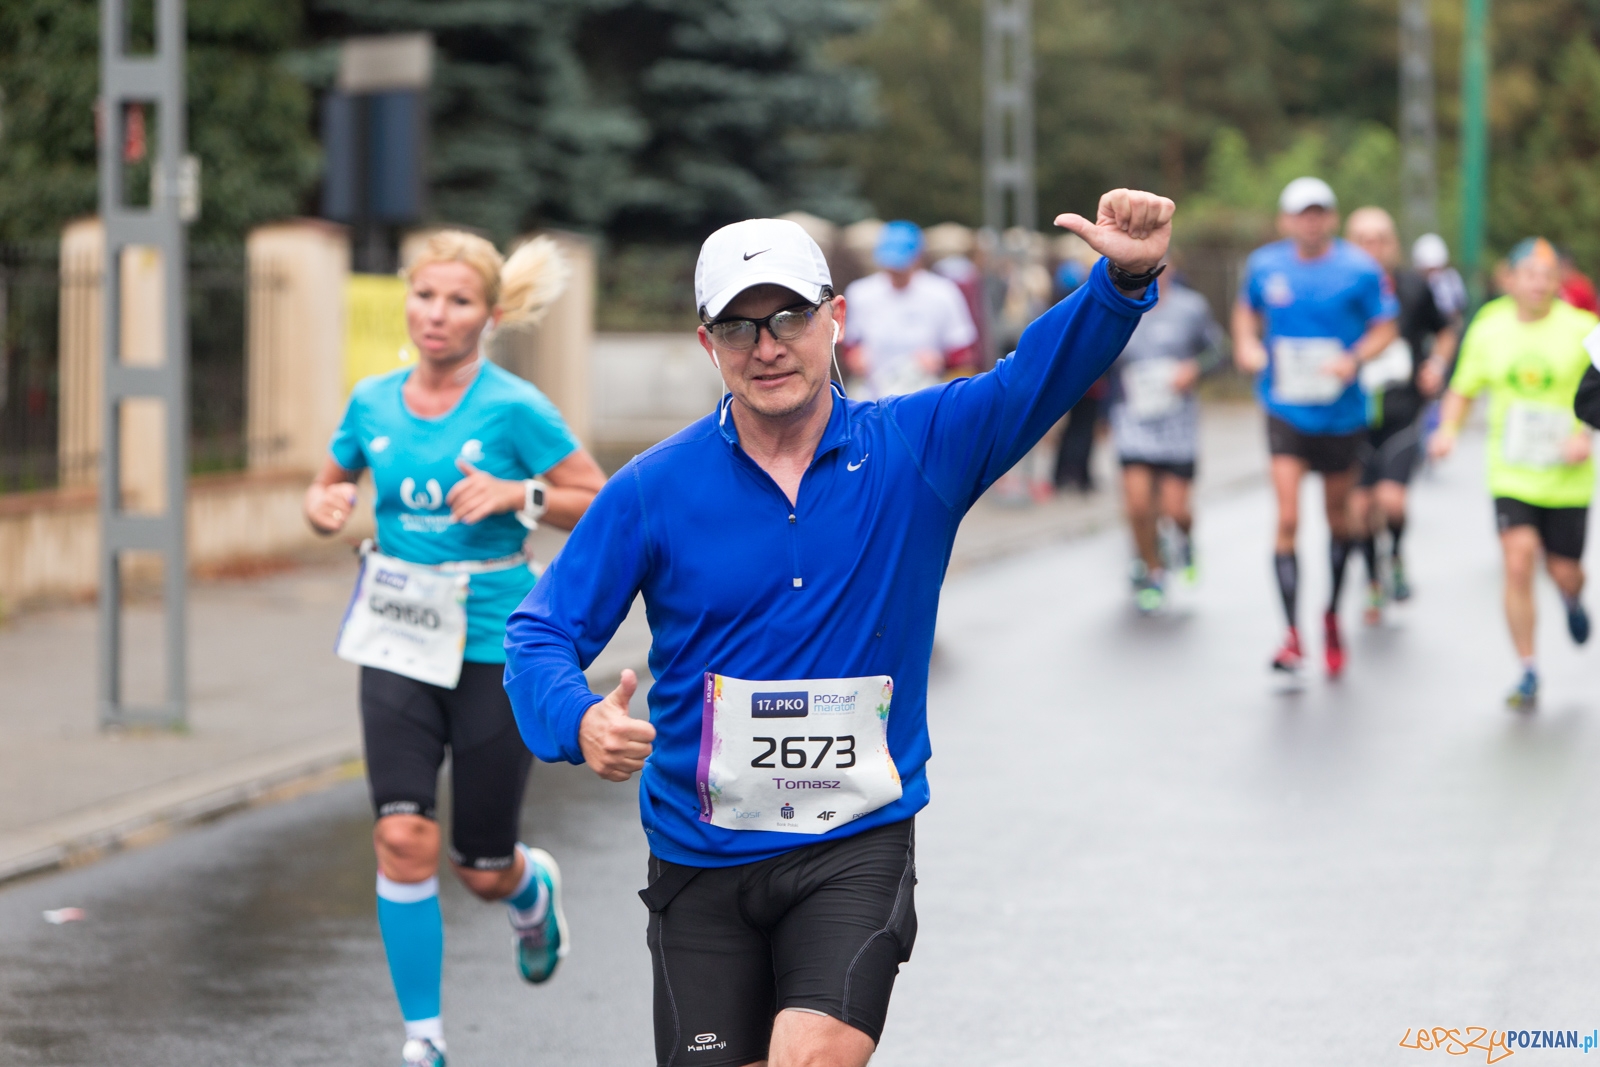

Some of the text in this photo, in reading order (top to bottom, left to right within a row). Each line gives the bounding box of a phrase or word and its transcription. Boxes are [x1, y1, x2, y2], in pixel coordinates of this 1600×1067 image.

[757, 698, 804, 711] 17. PKO
[814, 702, 855, 712] maraton
[751, 735, 856, 768] 2673
[772, 778, 841, 789] Tomasz
[817, 811, 836, 820] 4F
[687, 1041, 727, 1052] Kalenji
